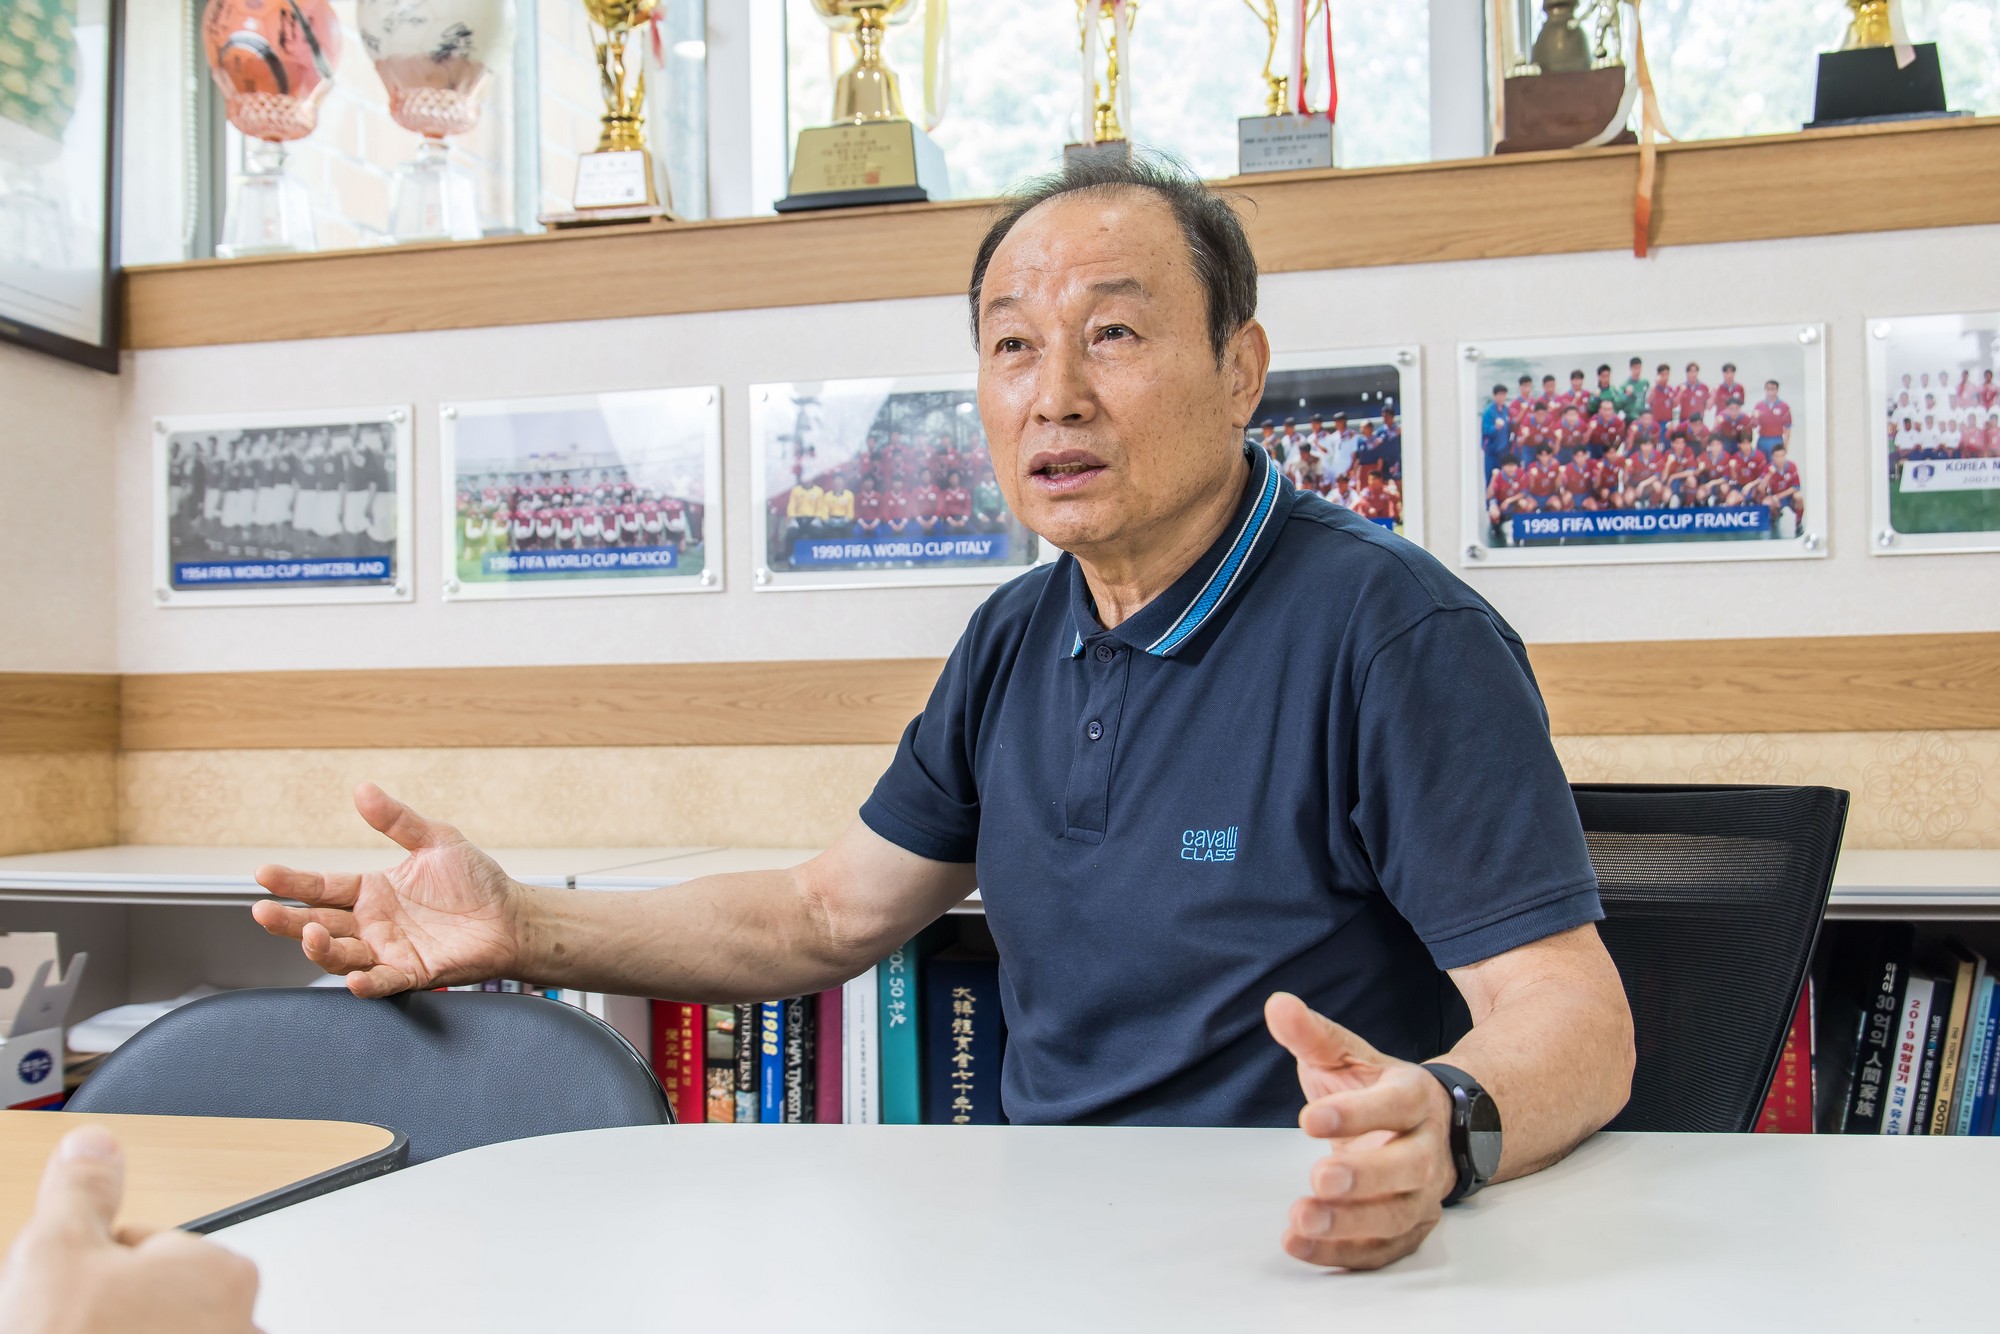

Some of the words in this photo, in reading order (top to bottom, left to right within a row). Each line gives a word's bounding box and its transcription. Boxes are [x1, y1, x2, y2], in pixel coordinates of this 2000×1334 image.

[1522, 518, 1559, 534] 1998
[1561, 516, 1597, 533] FIFA
[1597, 514, 1657, 532] WORLD
[1658, 513, 1693, 530] CUP
[1695, 511, 1760, 529] FRANCE
[489, 555, 519, 571] 1986
[519, 554, 546, 569] FIFA
[546, 553, 590, 569] WORLD
[592, 551, 620, 568] CUP
[621, 550, 672, 567] MEXICO
[811, 544, 843, 560] 1990
[844, 544, 872, 559] FIFA
[873, 542, 924, 558] WORLD
[925, 541, 955, 557] CUP
[956, 540, 992, 556] ITALY
[181, 566, 208, 582] 1954
[208, 565, 232, 580] FIFA
[234, 564, 275, 579] WORLD
[275, 563, 301, 578] CUP
[302, 561, 385, 577] SWITZERLAND
[1182, 826, 1238, 848] cavalli
[1181, 847, 1236, 862] CLASS
[1905, 1000, 1921, 1039] 2019
[762, 1010, 778, 1056] 1988
